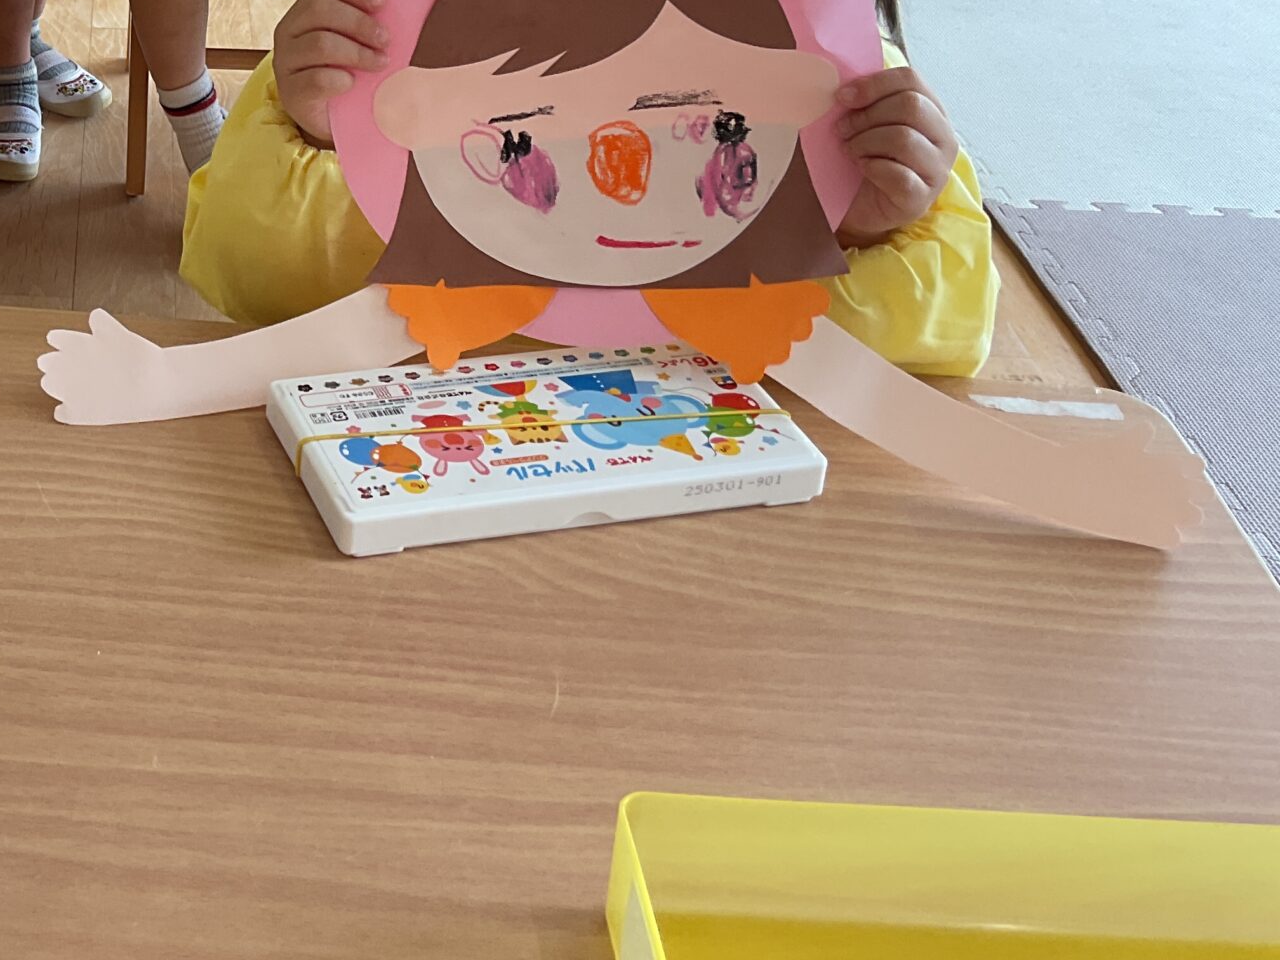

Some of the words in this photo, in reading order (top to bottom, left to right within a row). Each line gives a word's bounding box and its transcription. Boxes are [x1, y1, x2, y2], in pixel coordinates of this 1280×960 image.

[506, 457, 596, 480] パッセル
[683, 474, 782, 497] 250301-901
